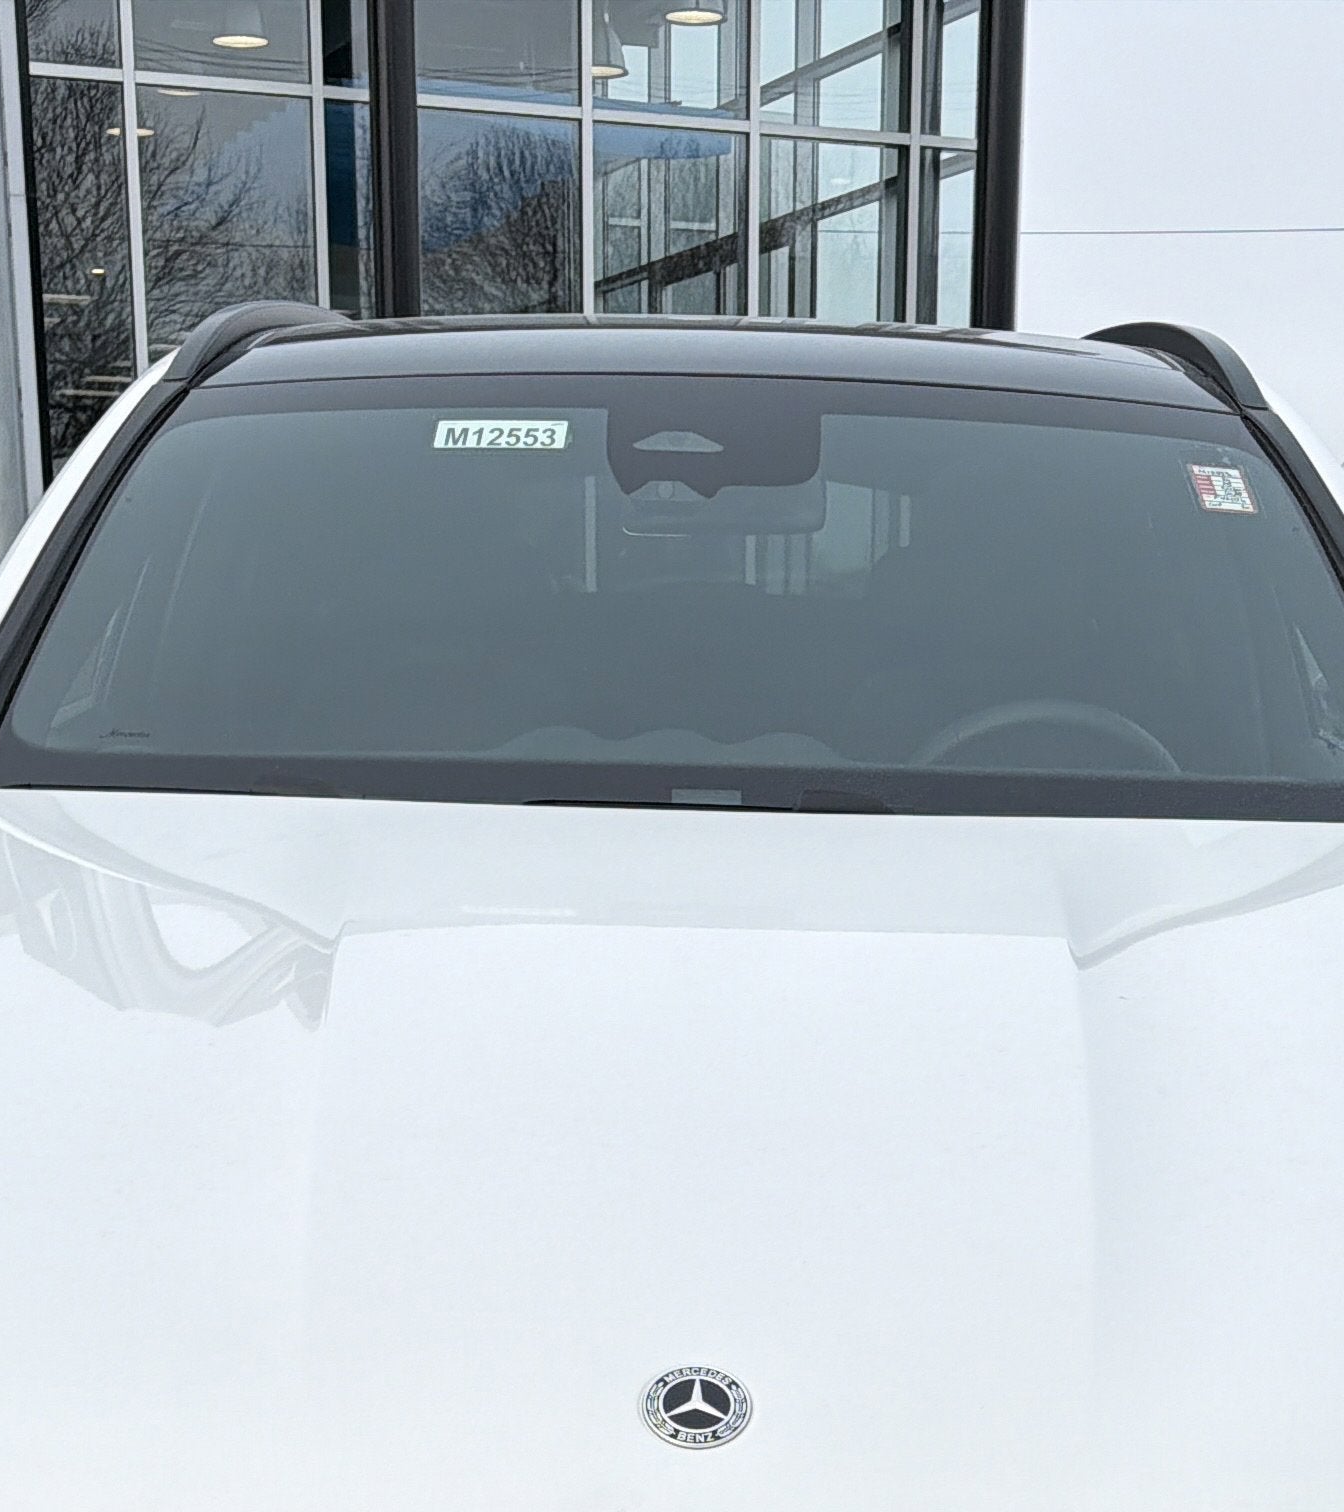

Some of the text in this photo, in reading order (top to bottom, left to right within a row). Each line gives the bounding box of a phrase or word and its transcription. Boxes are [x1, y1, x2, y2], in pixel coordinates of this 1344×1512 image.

[443, 426, 558, 447] M12553
[664, 1368, 732, 1385] MERCEDES
[676, 1433, 715, 1443] BENZ
